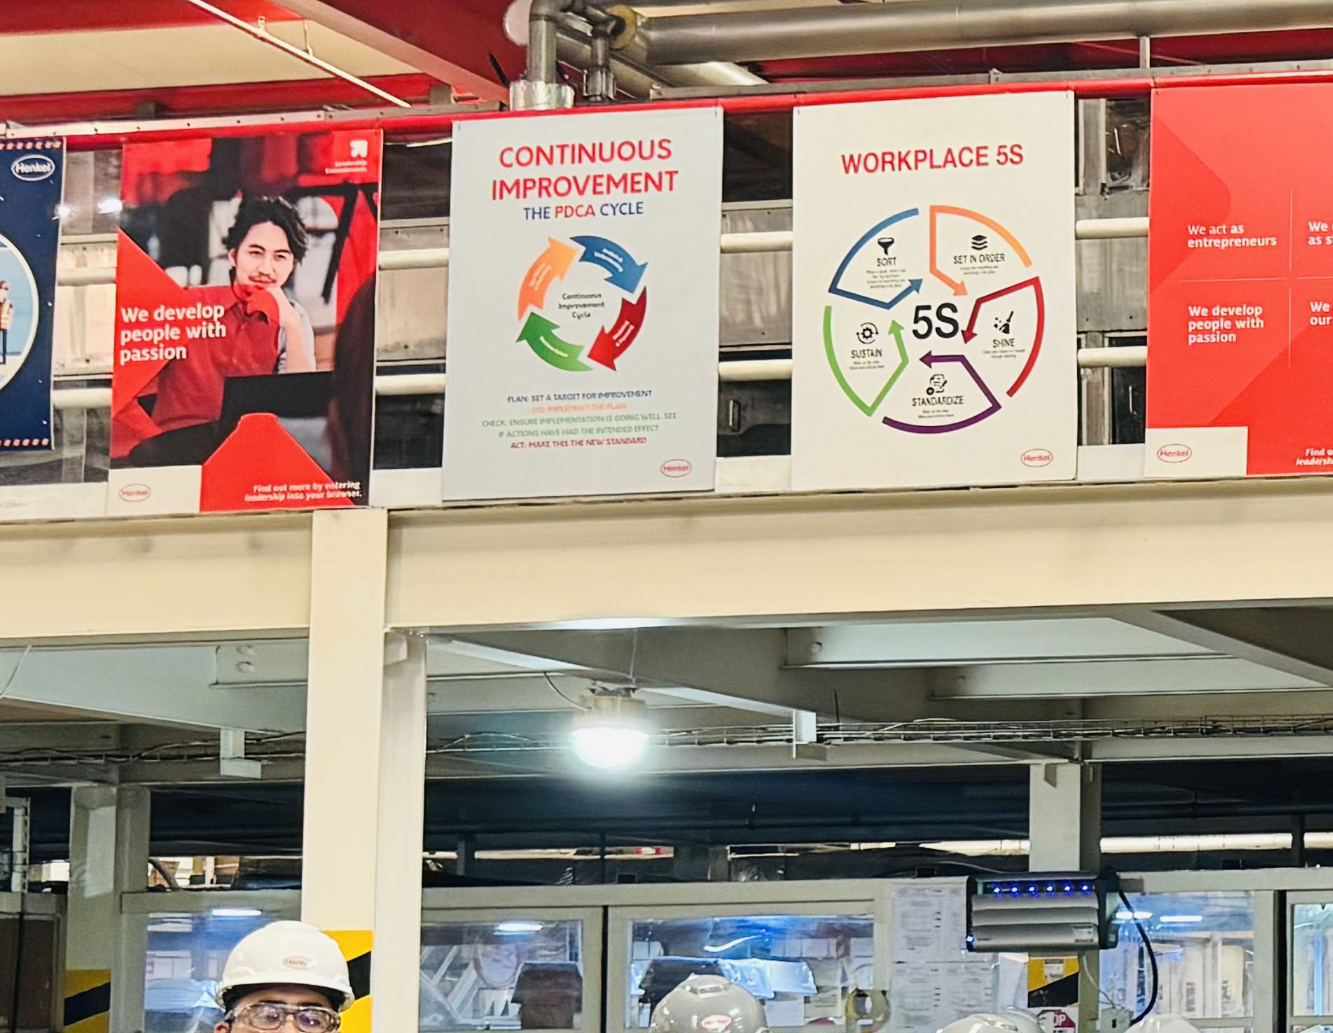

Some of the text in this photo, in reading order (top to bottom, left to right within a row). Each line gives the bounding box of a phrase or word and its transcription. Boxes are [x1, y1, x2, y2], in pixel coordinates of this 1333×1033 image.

[499, 139, 672, 168] CONTINUOUS
[841, 143, 1024, 174] WORKPLACE 5S
[15, 161, 51, 174] Henkel
[491, 170, 679, 201] IMPROVEMENT
[523, 201, 644, 220] THE PDCA CYCLE
[1188, 224, 1244, 235] We act as
[1308, 221, 1328, 232] We
[1188, 235, 1277, 249] entrepreneurs
[1308, 235, 1322, 246] as
[876, 257, 897, 267] SORT
[953, 253, 1005, 265] SET IN ORDER
[121, 302, 225, 323] We develop
[1188, 304, 1263, 318] We develop
[1310, 301, 1330, 312] We
[912, 302, 959, 340] 5S
[1188, 317, 1264, 332] people with
[1310, 315, 1331, 325] our
[120, 321, 227, 346] people with
[1188, 331, 1236, 345] passion
[992, 338, 1015, 349] SHINE
[120, 343, 187, 366] passion
[851, 349, 883, 359] SUSTAIN
[912, 396, 964, 407] STANDARDIZE
[1305, 448, 1326, 457] Find
[253, 484, 271, 493] Find
[289, 483, 311, 491] more
[312, 482, 323, 491] by
[324, 481, 360, 490] entering
